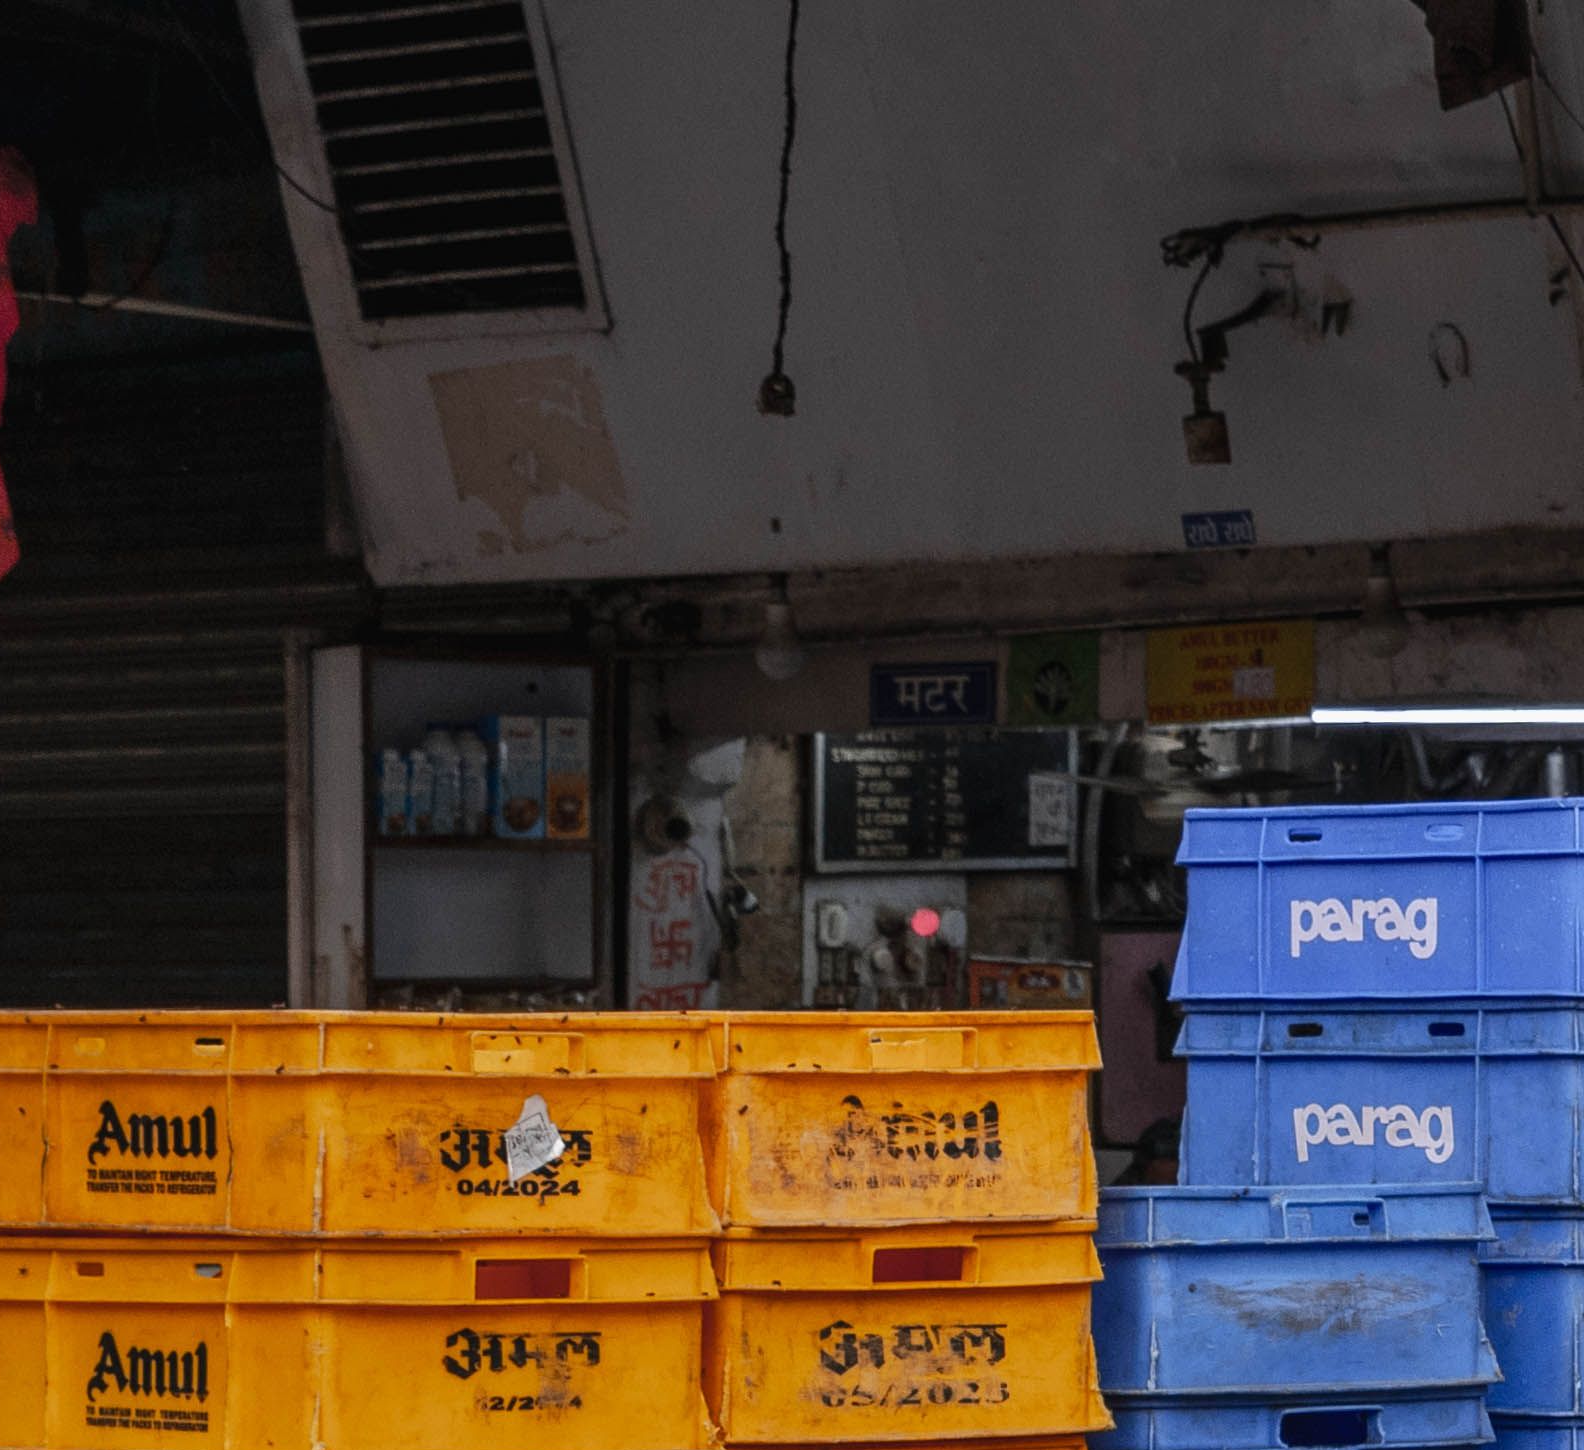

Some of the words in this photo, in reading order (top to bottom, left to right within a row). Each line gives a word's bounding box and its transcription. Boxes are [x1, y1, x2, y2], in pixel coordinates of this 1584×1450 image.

[894, 674, 971, 714] मटर
[1290, 897, 1438, 959] parag
[87, 1101, 218, 1165] Amul
[1293, 1103, 1455, 1164] parag
[457, 1178, 581, 1197] 04/2024
[86, 1331, 209, 1403] Amul
